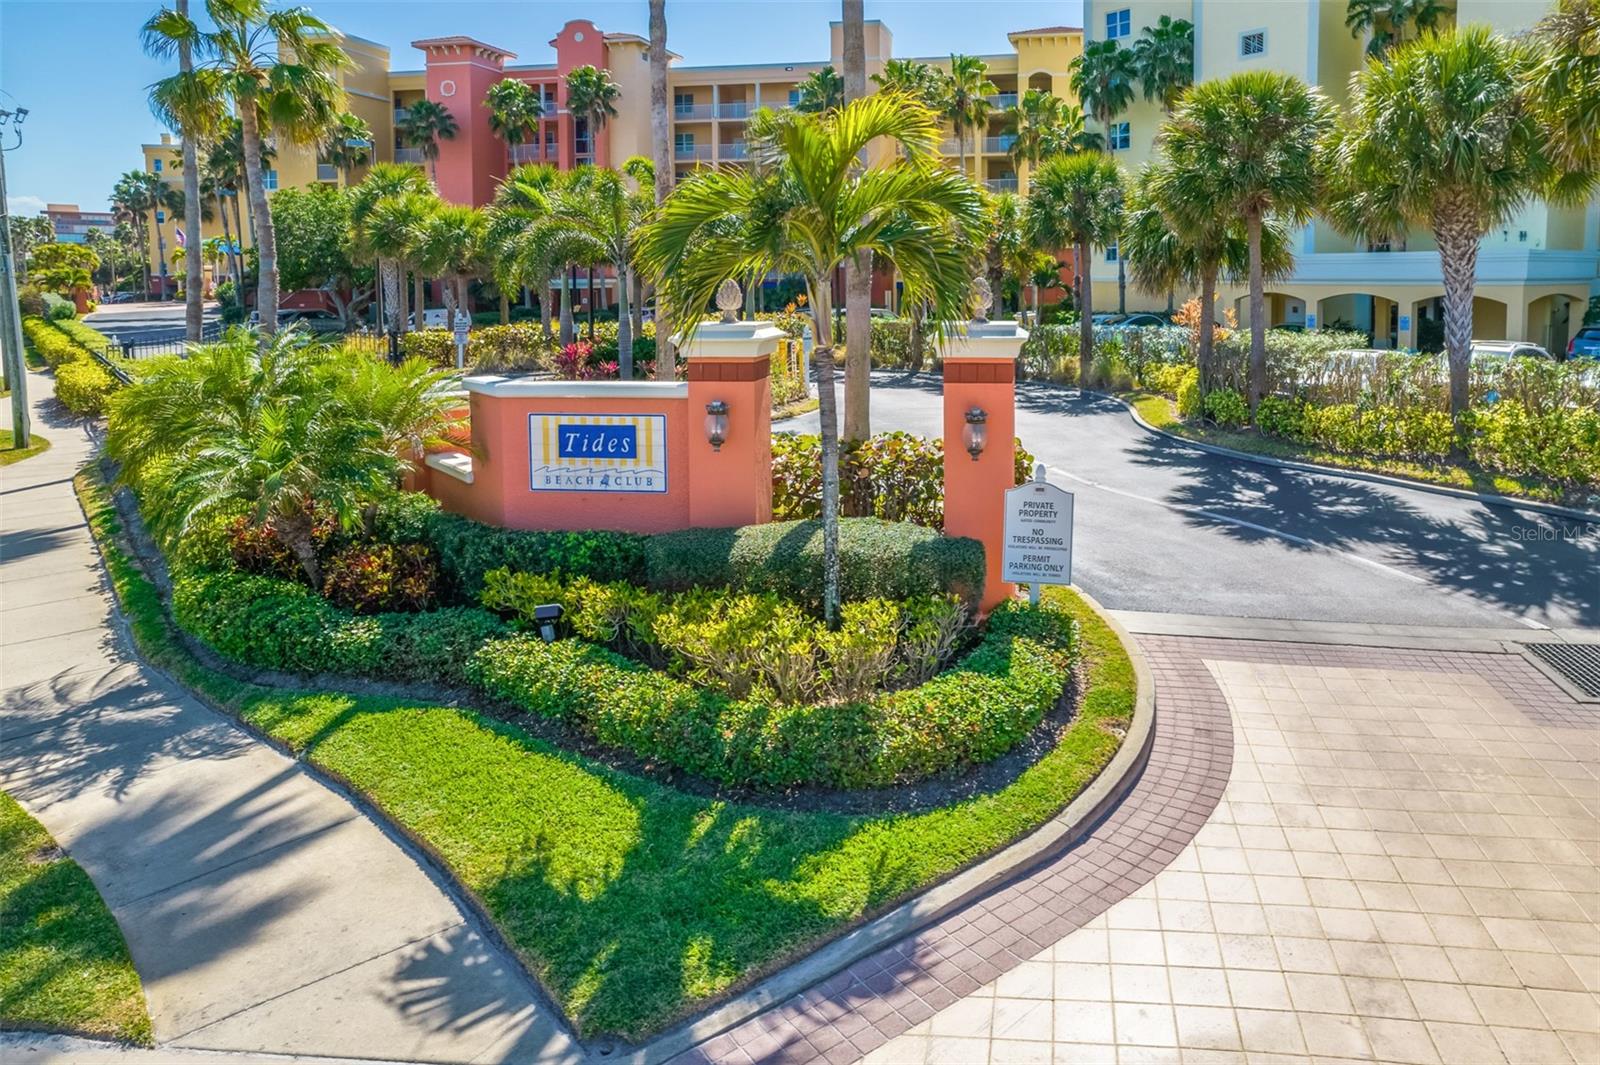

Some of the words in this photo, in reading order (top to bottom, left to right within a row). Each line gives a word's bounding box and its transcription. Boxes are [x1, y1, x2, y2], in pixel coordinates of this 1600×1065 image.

[565, 432, 631, 453] Tides
[545, 475, 594, 485] BEACH
[614, 476, 653, 486] CLUB
[1023, 501, 1054, 510] PRIVATE
[1019, 509, 1058, 518] PROPERTY
[1031, 528, 1044, 536] NO
[1012, 536, 1063, 545] TRESPASSING
[1023, 555, 1051, 563] PERMIT
[1009, 562, 1042, 571] PARKING
[1043, 564, 1064, 572] ONLY
